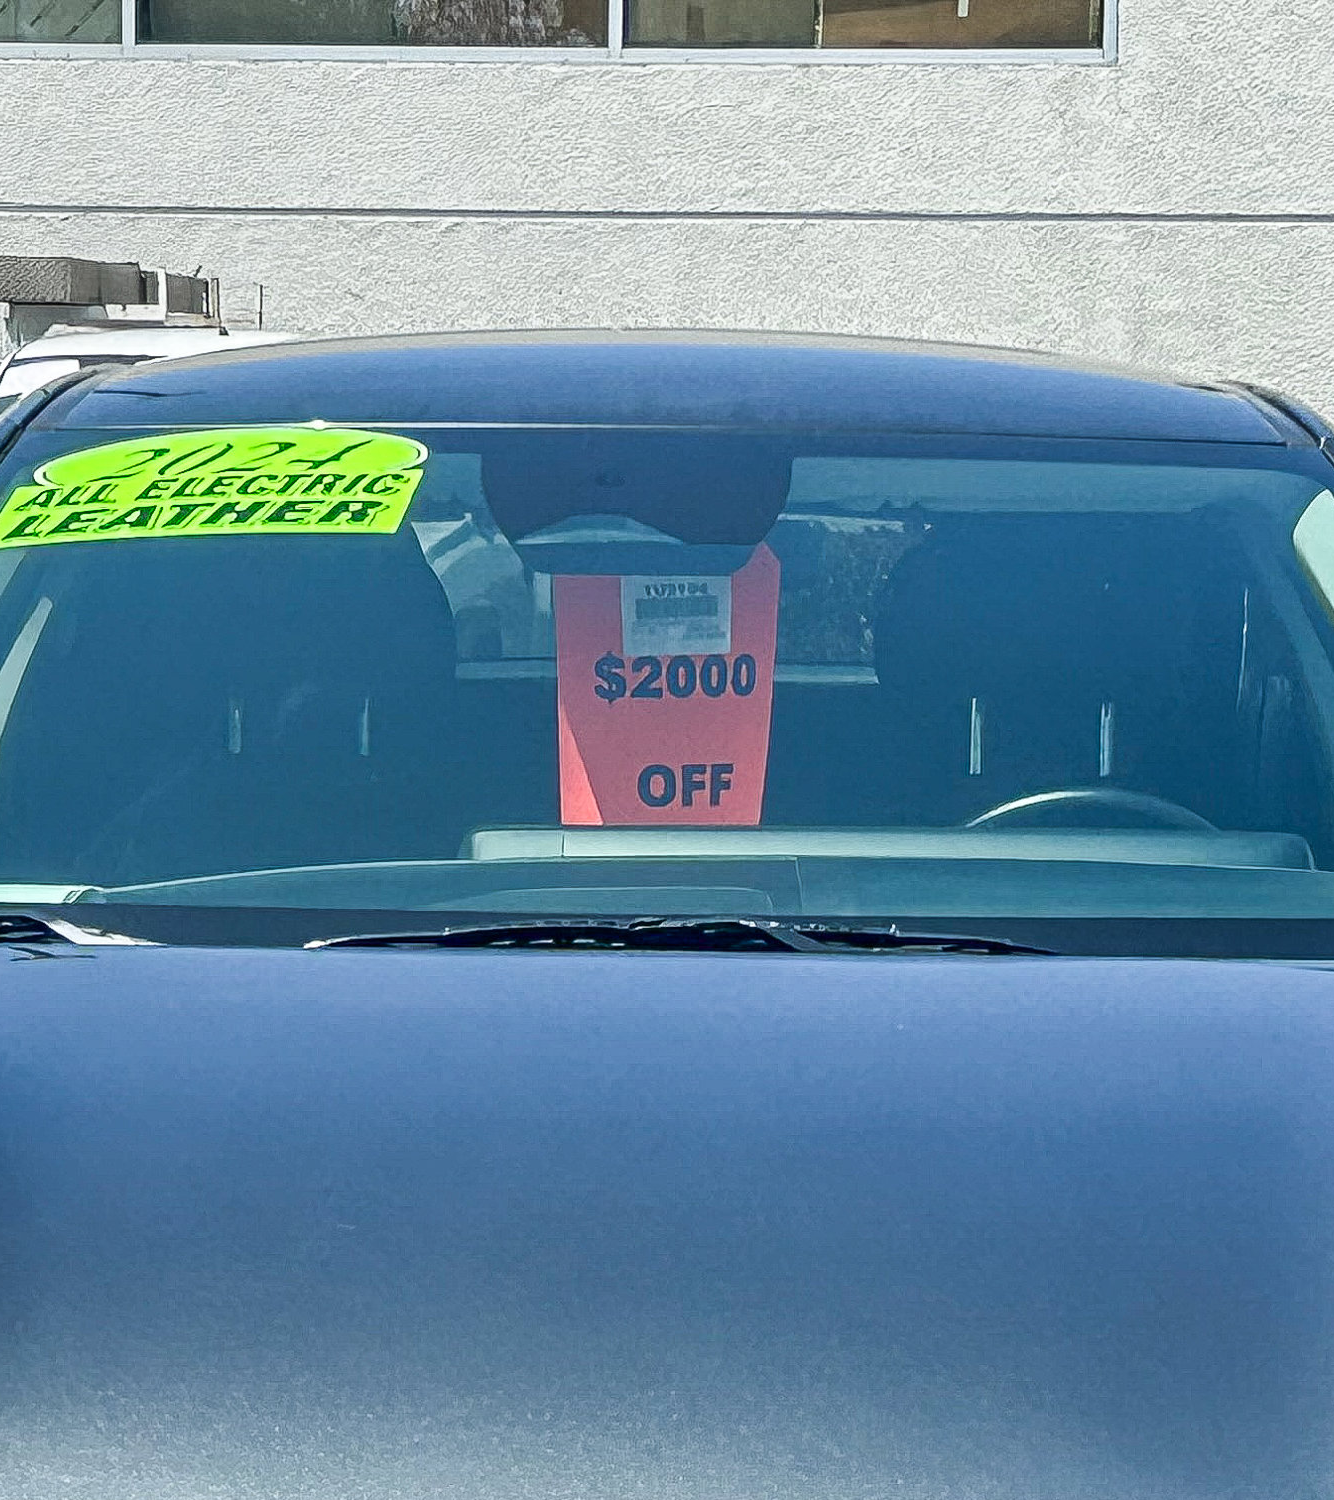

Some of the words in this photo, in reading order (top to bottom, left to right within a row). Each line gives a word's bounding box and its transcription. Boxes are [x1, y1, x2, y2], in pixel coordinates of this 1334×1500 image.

[13, 482, 117, 512] ALL
[135, 473, 407, 501] ELECTRIC
[3, 498, 384, 540] LEATHER
[594, 651, 757, 704] $2000
[637, 763, 734, 807] OFF
